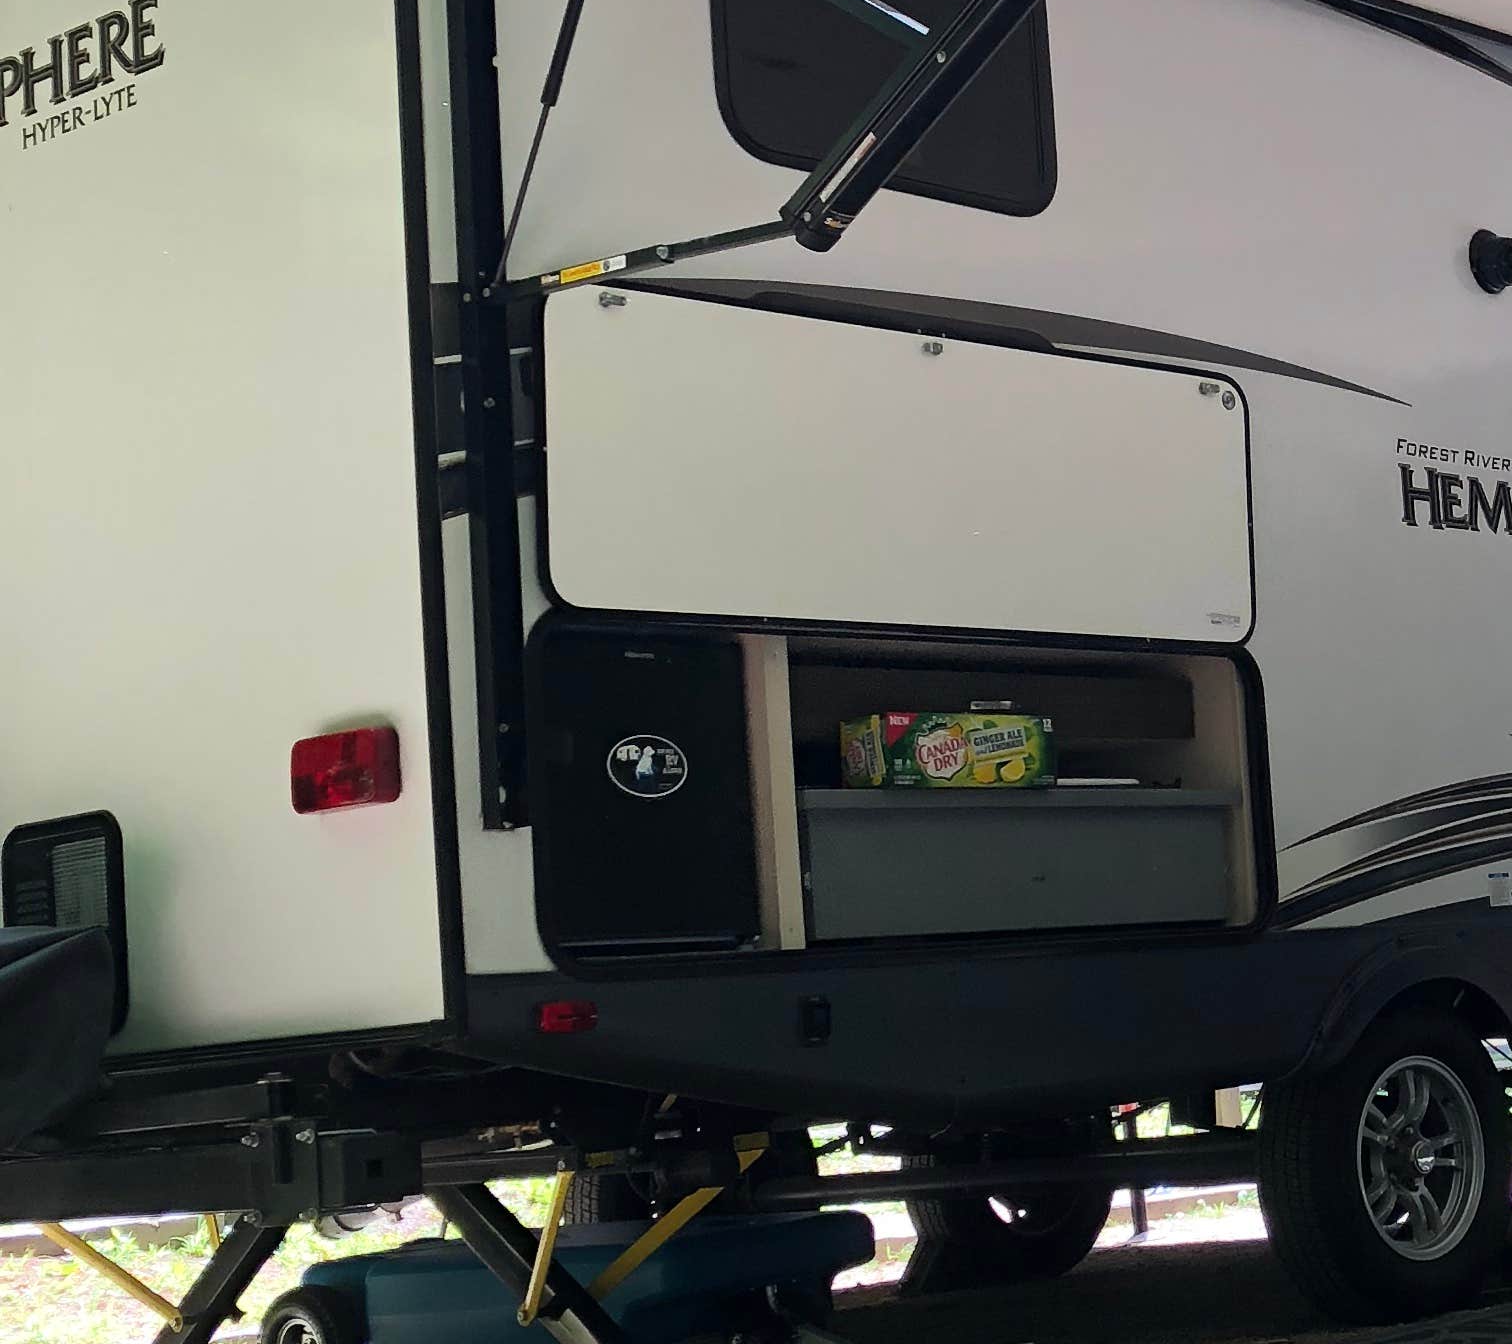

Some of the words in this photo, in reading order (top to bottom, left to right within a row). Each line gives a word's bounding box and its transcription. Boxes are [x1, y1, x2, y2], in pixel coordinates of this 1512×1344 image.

[22, 83, 138, 150] HYPER-LYTE
[1396, 438, 1460, 463] FOREST
[1463, 449, 1512, 472] RIVER
[918, 737, 969, 765] CANADA
[973, 732, 1006, 747] GINGER
[1007, 728, 1023, 741] ALE
[934, 752, 959, 772] DRY
